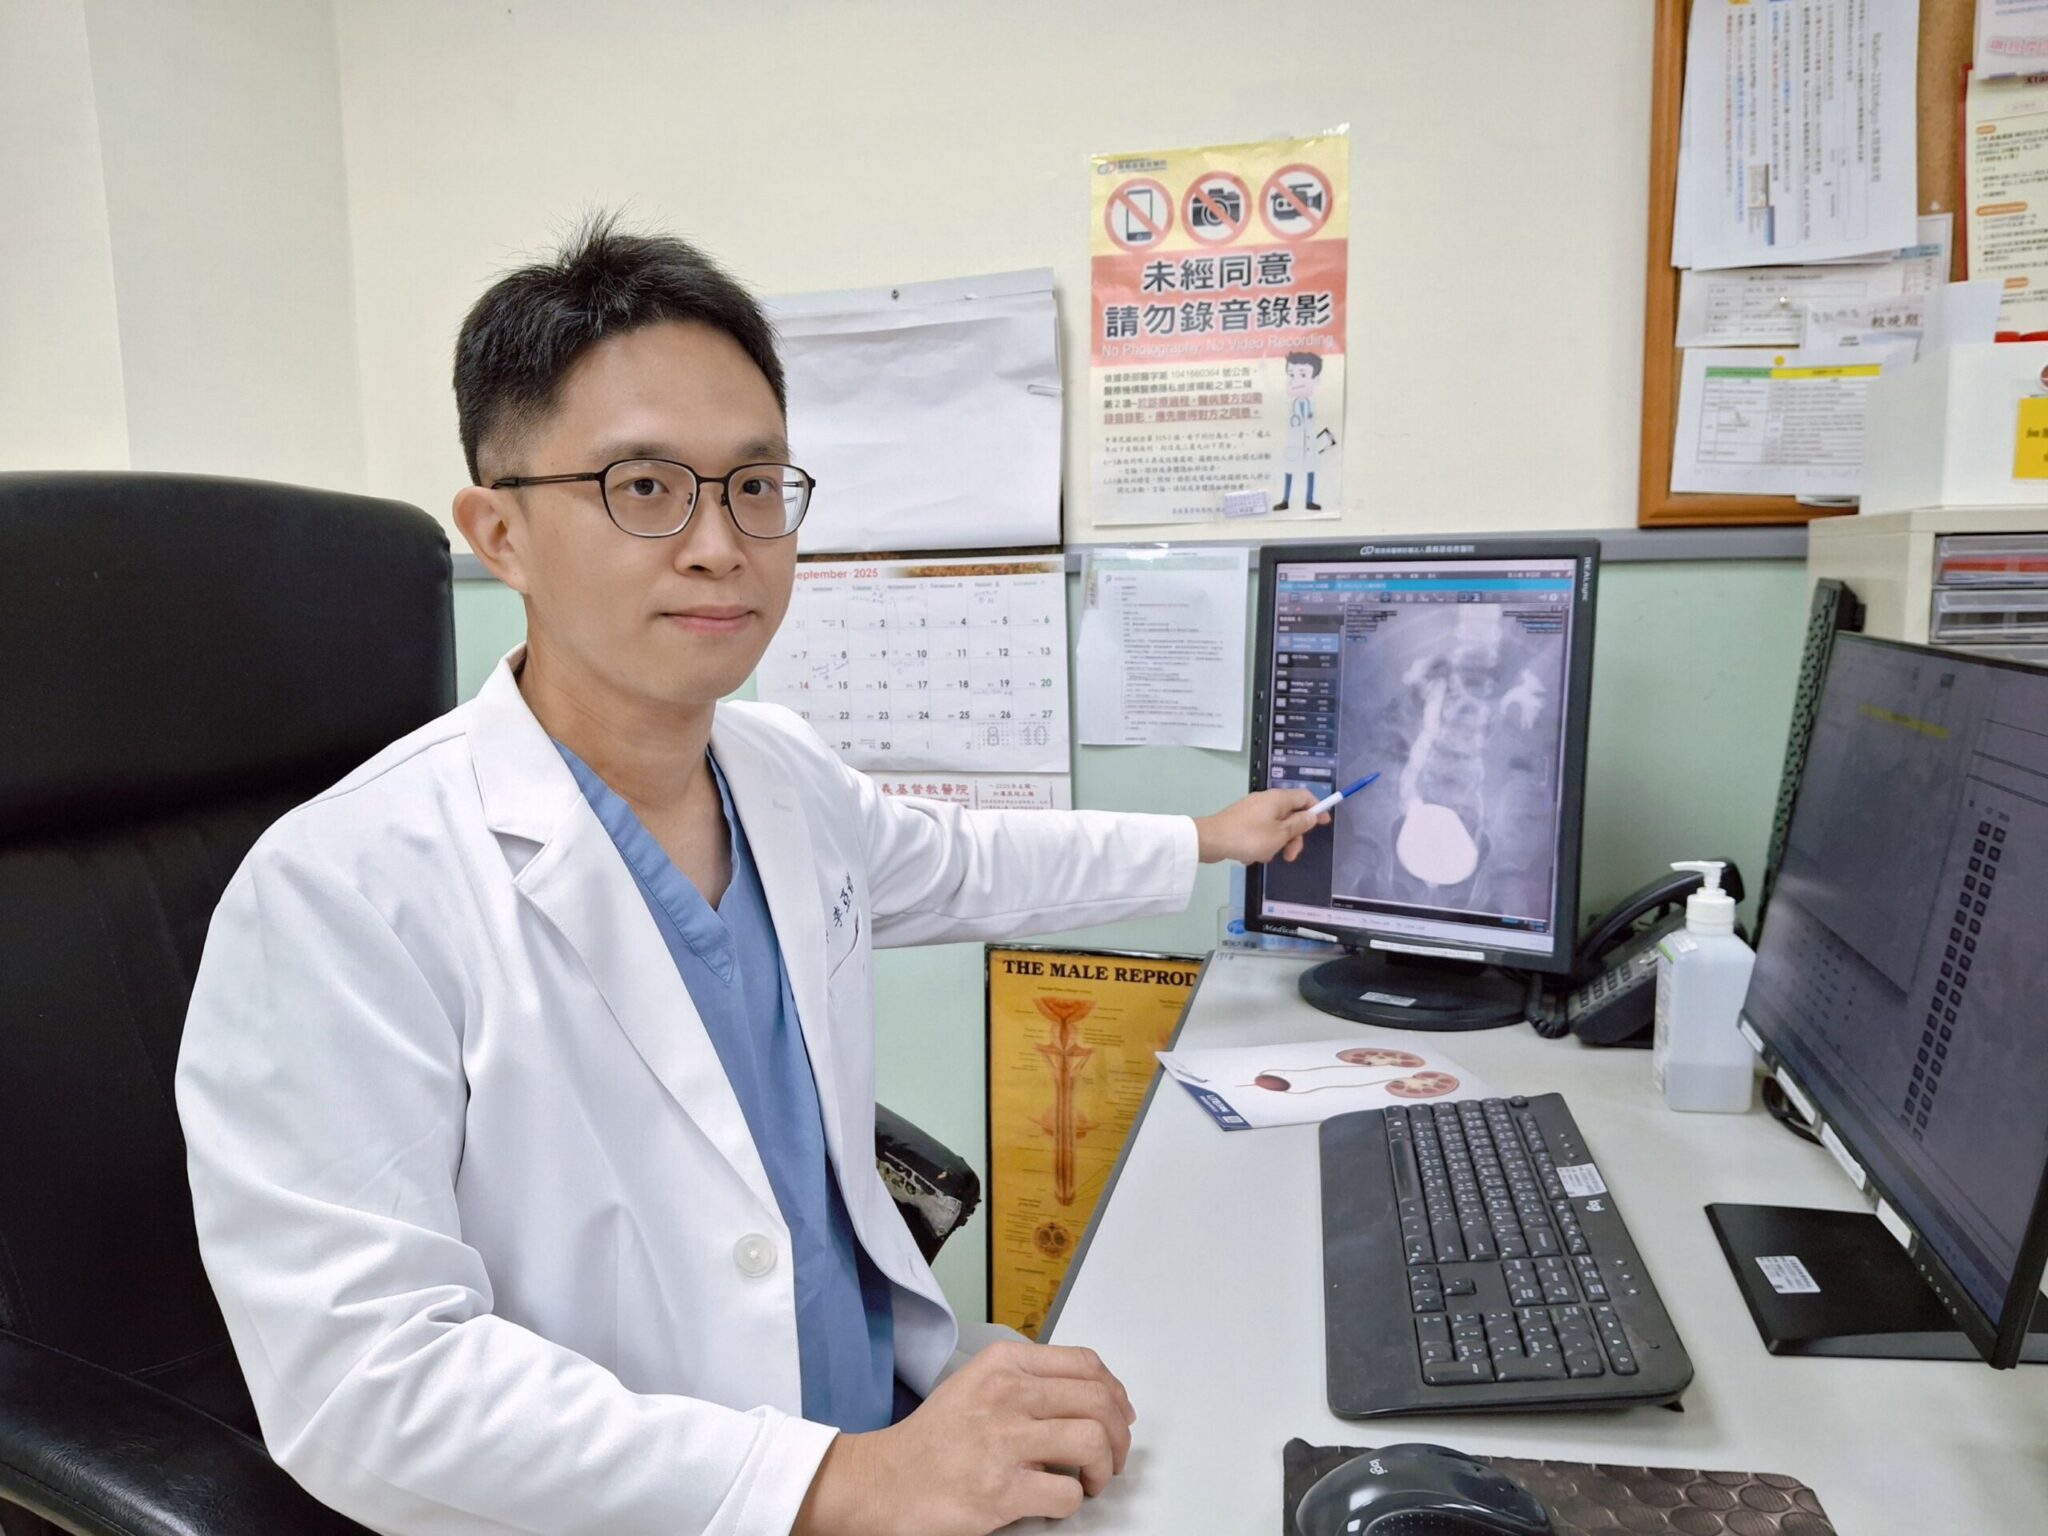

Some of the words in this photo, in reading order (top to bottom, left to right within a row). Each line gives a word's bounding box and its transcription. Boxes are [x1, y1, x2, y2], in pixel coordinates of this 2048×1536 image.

[1143, 253, 1292, 292] 未經同意
[1105, 294, 1330, 337] 請勿錄音錄影
[1102, 343, 1119, 356] No
[1207, 338, 1224, 351] No
[1229, 336, 1263, 350] Video
[854, 568, 878, 578] 2025
[841, 620, 844, 628] 1
[880, 619, 885, 627] 2
[921, 618, 925, 627] 3
[1003, 616, 1008, 625] 5
[803, 651, 807, 659] 7
[841, 651, 847, 659] 8
[917, 650, 927, 658] 10
[999, 648, 1008, 656] 12
[1041, 647, 1051, 655] 13
[839, 681, 848, 689] 15
[879, 681, 887, 689] 16
[959, 680, 968, 688] 18
[1041, 679, 1051, 687] 20
[840, 712, 849, 720] 22
[879, 712, 889, 720] 23
[960, 711, 969, 719] 25
[1001, 711, 1011, 719] 26
[1042, 710, 1052, 718] 27
[881, 742, 891, 750] 30
[1003, 960, 1044, 976] THE
[1050, 963, 1108, 981] MALE
[1114, 967, 1198, 987] REPROD
[1369, 1459, 1388, 1475] logi
